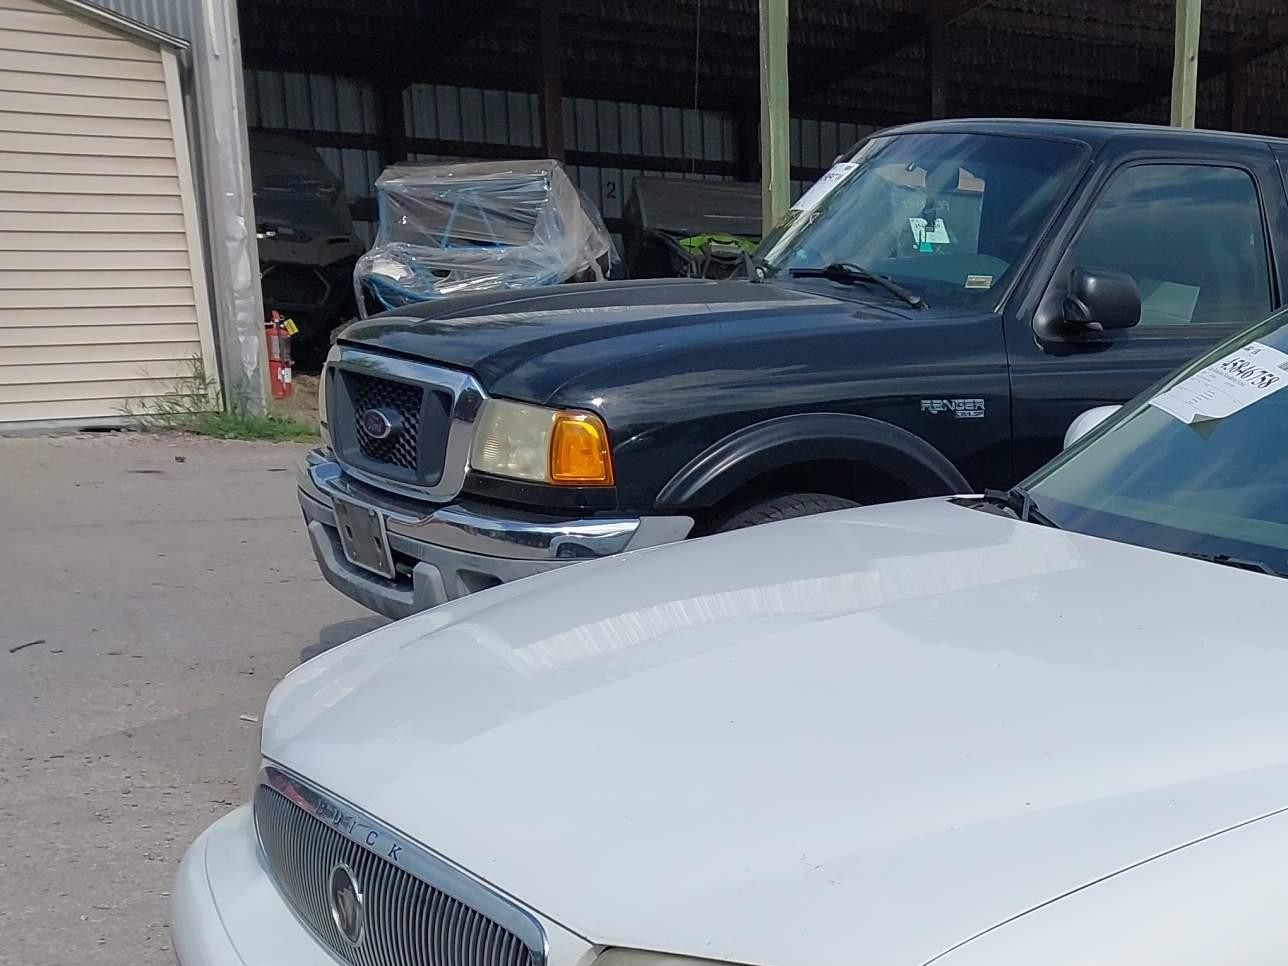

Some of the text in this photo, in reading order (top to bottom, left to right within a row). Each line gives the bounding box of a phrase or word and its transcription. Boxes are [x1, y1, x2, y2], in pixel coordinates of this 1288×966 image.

[606, 181, 617, 199] 2
[1221, 357, 1280, 389] 45846758
[921, 399, 985, 414] RANGER
[316, 802, 403, 861] BUICK
